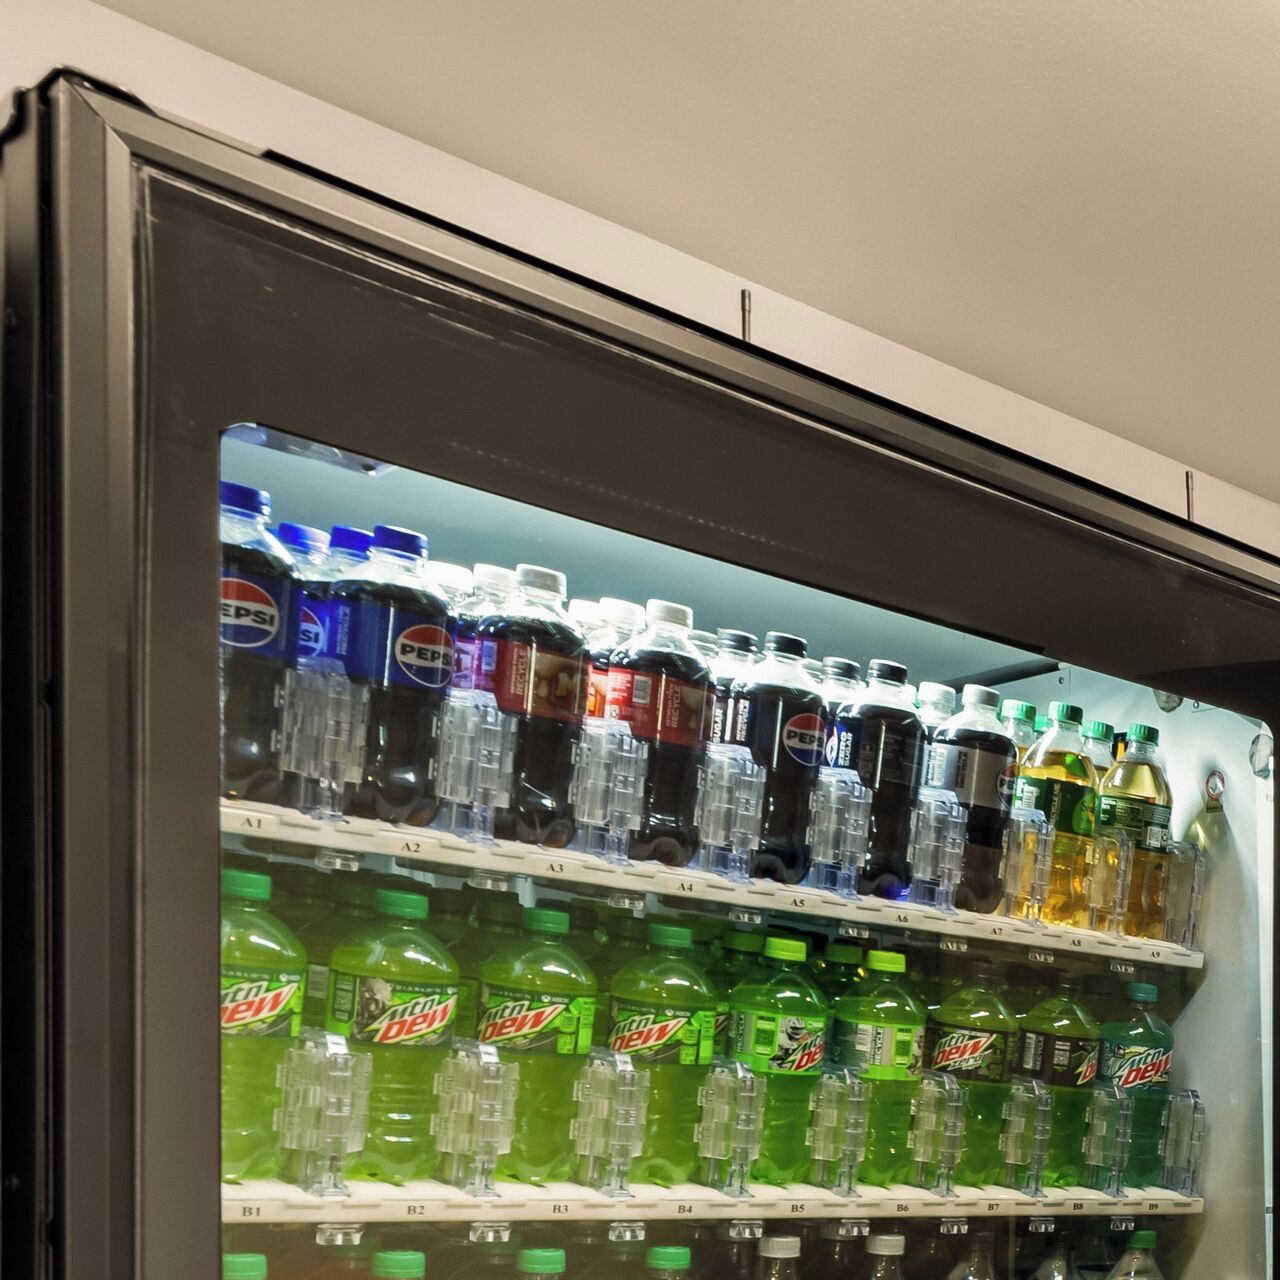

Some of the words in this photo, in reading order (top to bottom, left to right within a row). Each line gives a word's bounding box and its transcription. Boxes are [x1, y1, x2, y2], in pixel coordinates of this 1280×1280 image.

[221, 602, 276, 627] EPSI
[241, 816, 263, 829] A1
[400, 841, 421, 853] A2
[546, 862, 564, 873] A3
[676, 882, 693, 892] A4
[789, 898, 805, 908] A5
[895, 914, 909, 923] A6
[990, 927, 1002, 936] A7
[241, 1206, 261, 1217] B1
[407, 1204, 425, 1215] B2
[552, 1203, 569, 1214] B3
[677, 1203, 692, 1214] B4
[790, 1203, 805, 1213] B5
[896, 1203, 909, 1212] B6
[988, 1203, 1000, 1212] B7
